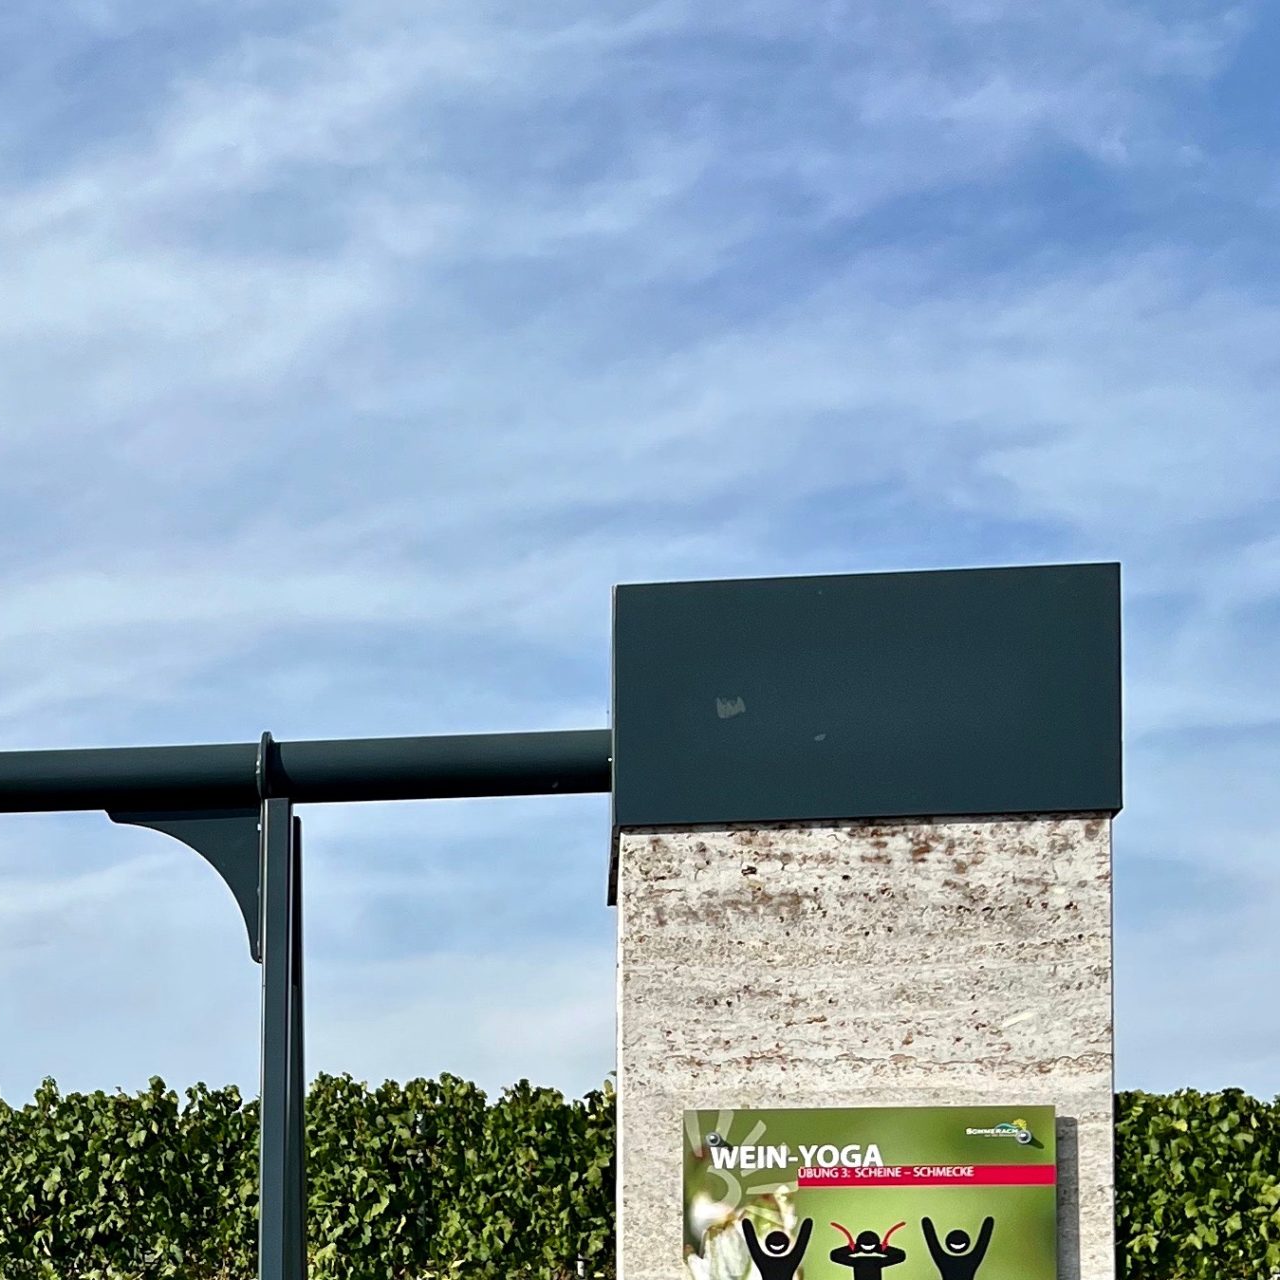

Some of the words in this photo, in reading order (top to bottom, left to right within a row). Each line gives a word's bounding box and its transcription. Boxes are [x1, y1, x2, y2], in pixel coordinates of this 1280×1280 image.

[710, 1144, 883, 1169] WEIN-YOGA
[798, 1166, 839, 1179] ÜBUNG
[841, 1168, 851, 1178] 3:
[855, 1167, 902, 1178] SCHEINE
[913, 1166, 975, 1178] SCHMECKE
